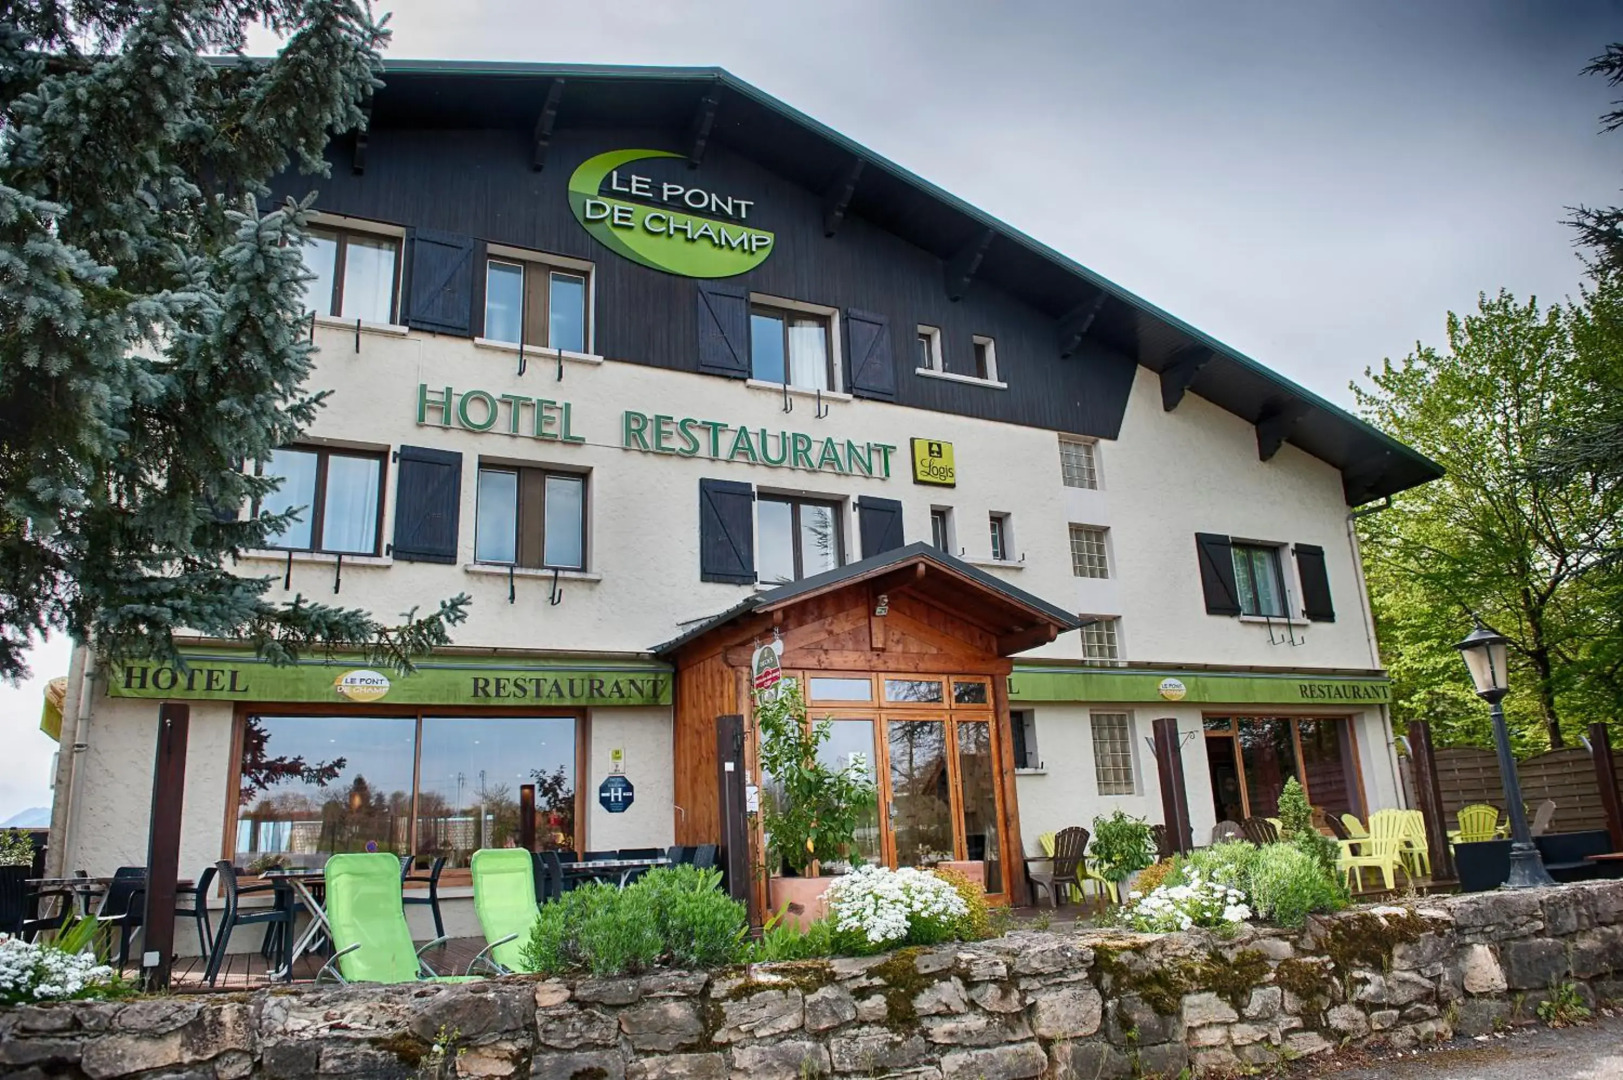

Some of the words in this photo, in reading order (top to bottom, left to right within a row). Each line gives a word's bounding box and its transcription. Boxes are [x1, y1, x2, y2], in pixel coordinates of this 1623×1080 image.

[611, 170, 653, 197] LE
[662, 182, 754, 219] PONT
[585, 198, 635, 227] DE
[644, 212, 771, 252] CHAMP
[417, 383, 586, 444] HOTEL
[622, 410, 897, 479] RESTAURANT
[920, 457, 954, 481] Logis
[121, 665, 249, 693] HOTEL
[344, 677, 357, 685] LE
[360, 677, 385, 685] PONT
[471, 676, 665, 699] RESTAURANT
[1298, 684, 1389, 699] RESTAURANT
[610, 787, 623, 802] H
